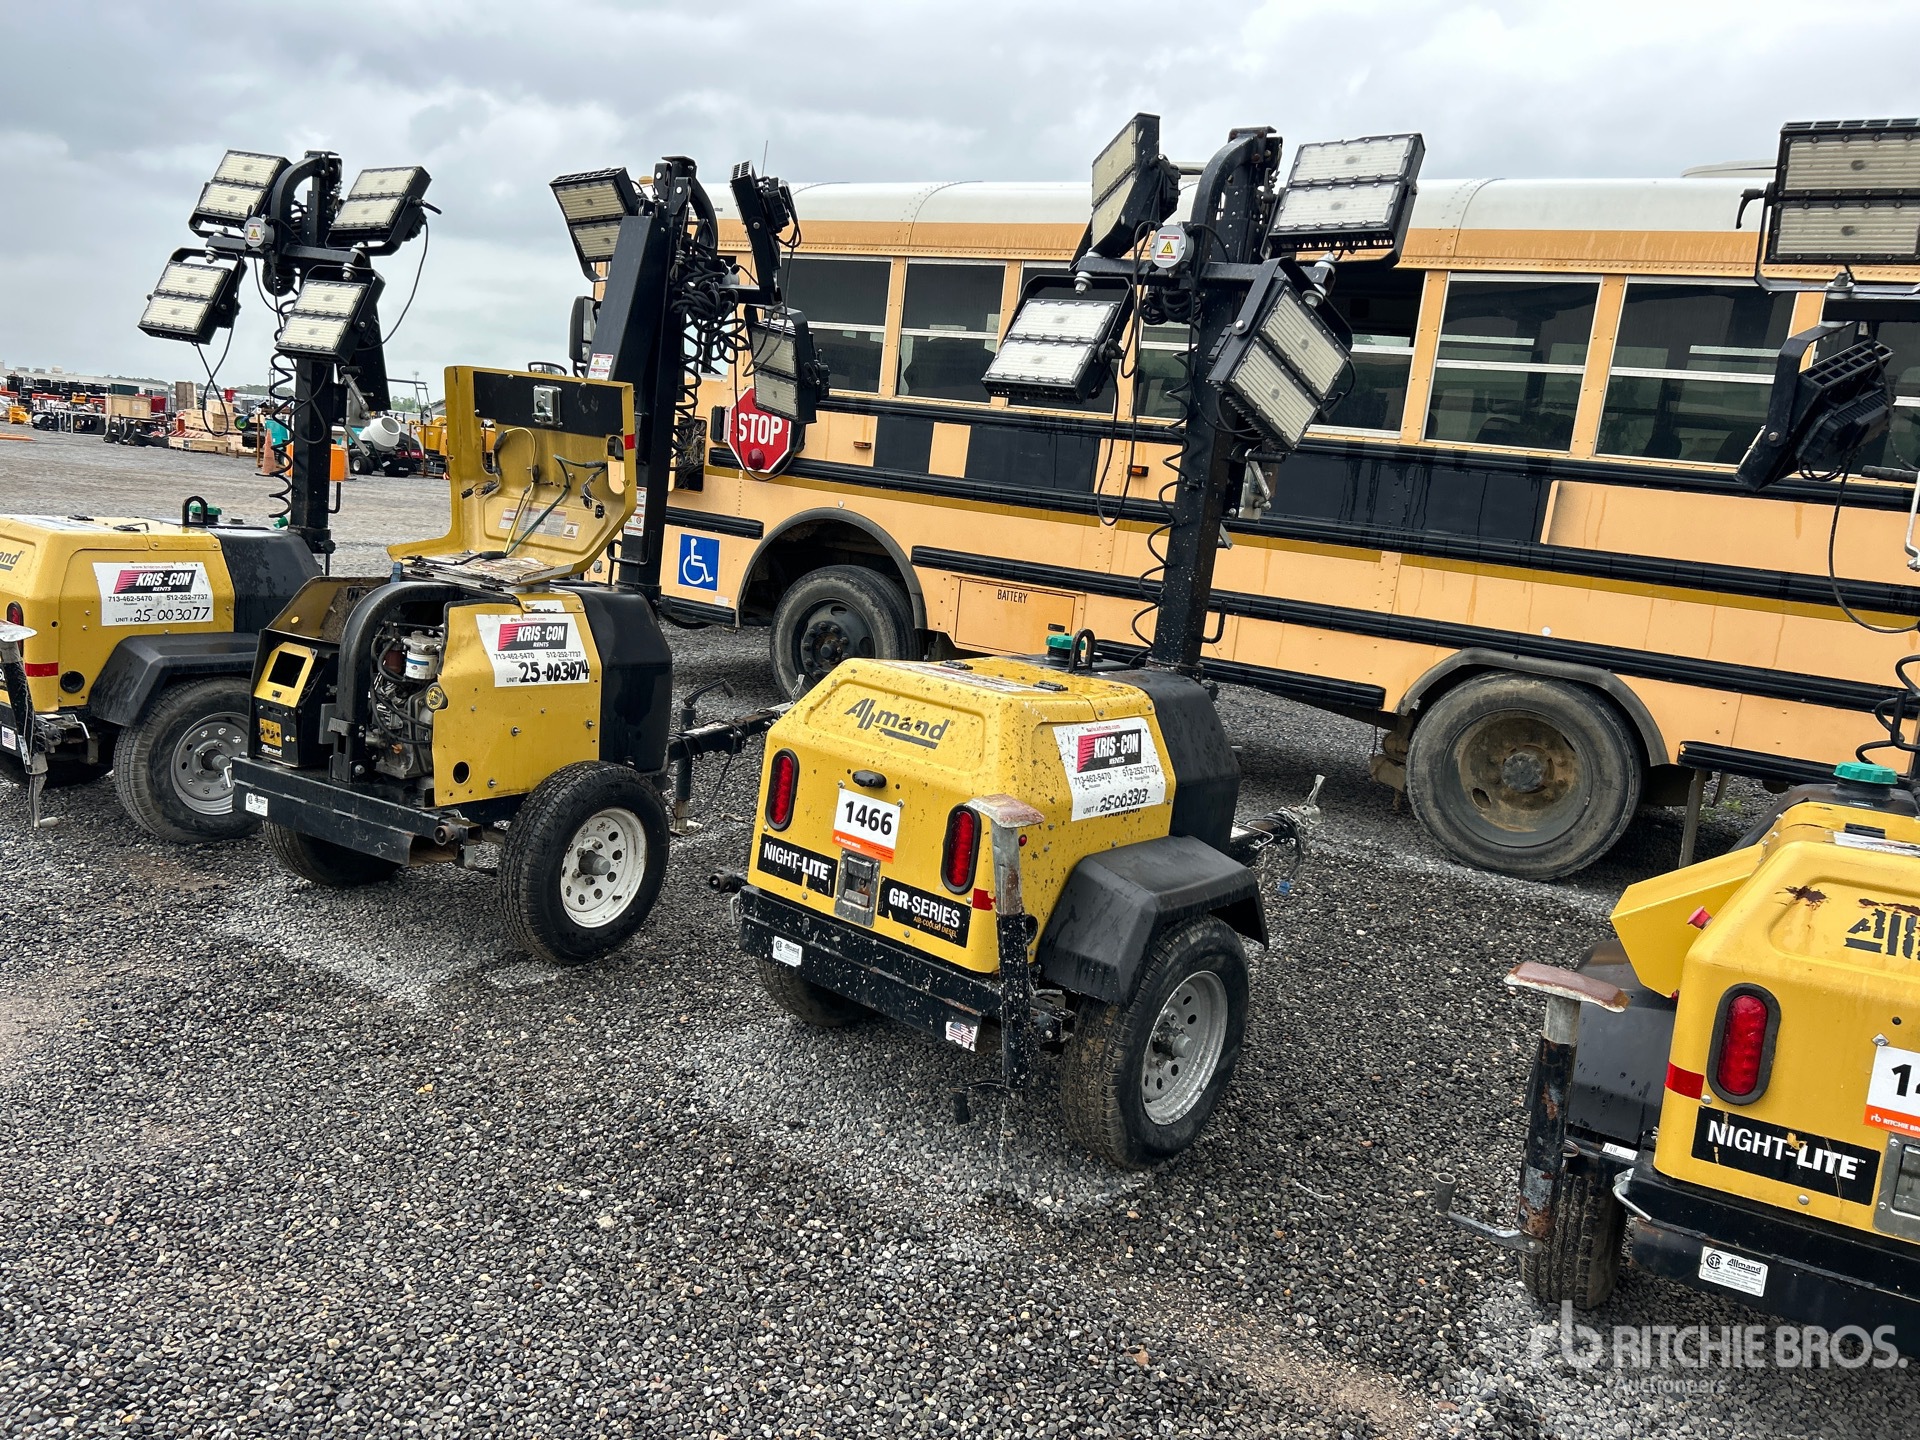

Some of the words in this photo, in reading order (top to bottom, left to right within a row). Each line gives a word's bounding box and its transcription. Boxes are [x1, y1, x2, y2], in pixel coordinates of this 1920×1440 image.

[736, 412, 783, 446] STOP
[136, 572, 192, 587] KRIS-CON
[108, 595, 153, 603] 713-462-5470
[166, 593, 208, 601] 512-252-7737
[997, 589, 1028, 604] BATTERY
[134, 606, 210, 623] 25-003077
[516, 625, 565, 642] KRIS-CON
[494, 652, 535, 660] 713-462-5470
[518, 659, 590, 683] 25-003074
[843, 697, 951, 741] Allmand
[1093, 732, 1139, 759] KRIS-CON
[844, 800, 894, 836] 1466
[763, 842, 829, 881] NIGHT-LITE
[888, 887, 961, 928] GR-SERIES
[913, 916, 941, 931] AIR-COOLED
[941, 926, 957, 938] DIESEL
[1706, 1120, 1860, 1181] NIGHT-LITE
[1727, 1258, 1762, 1274] Allmand
